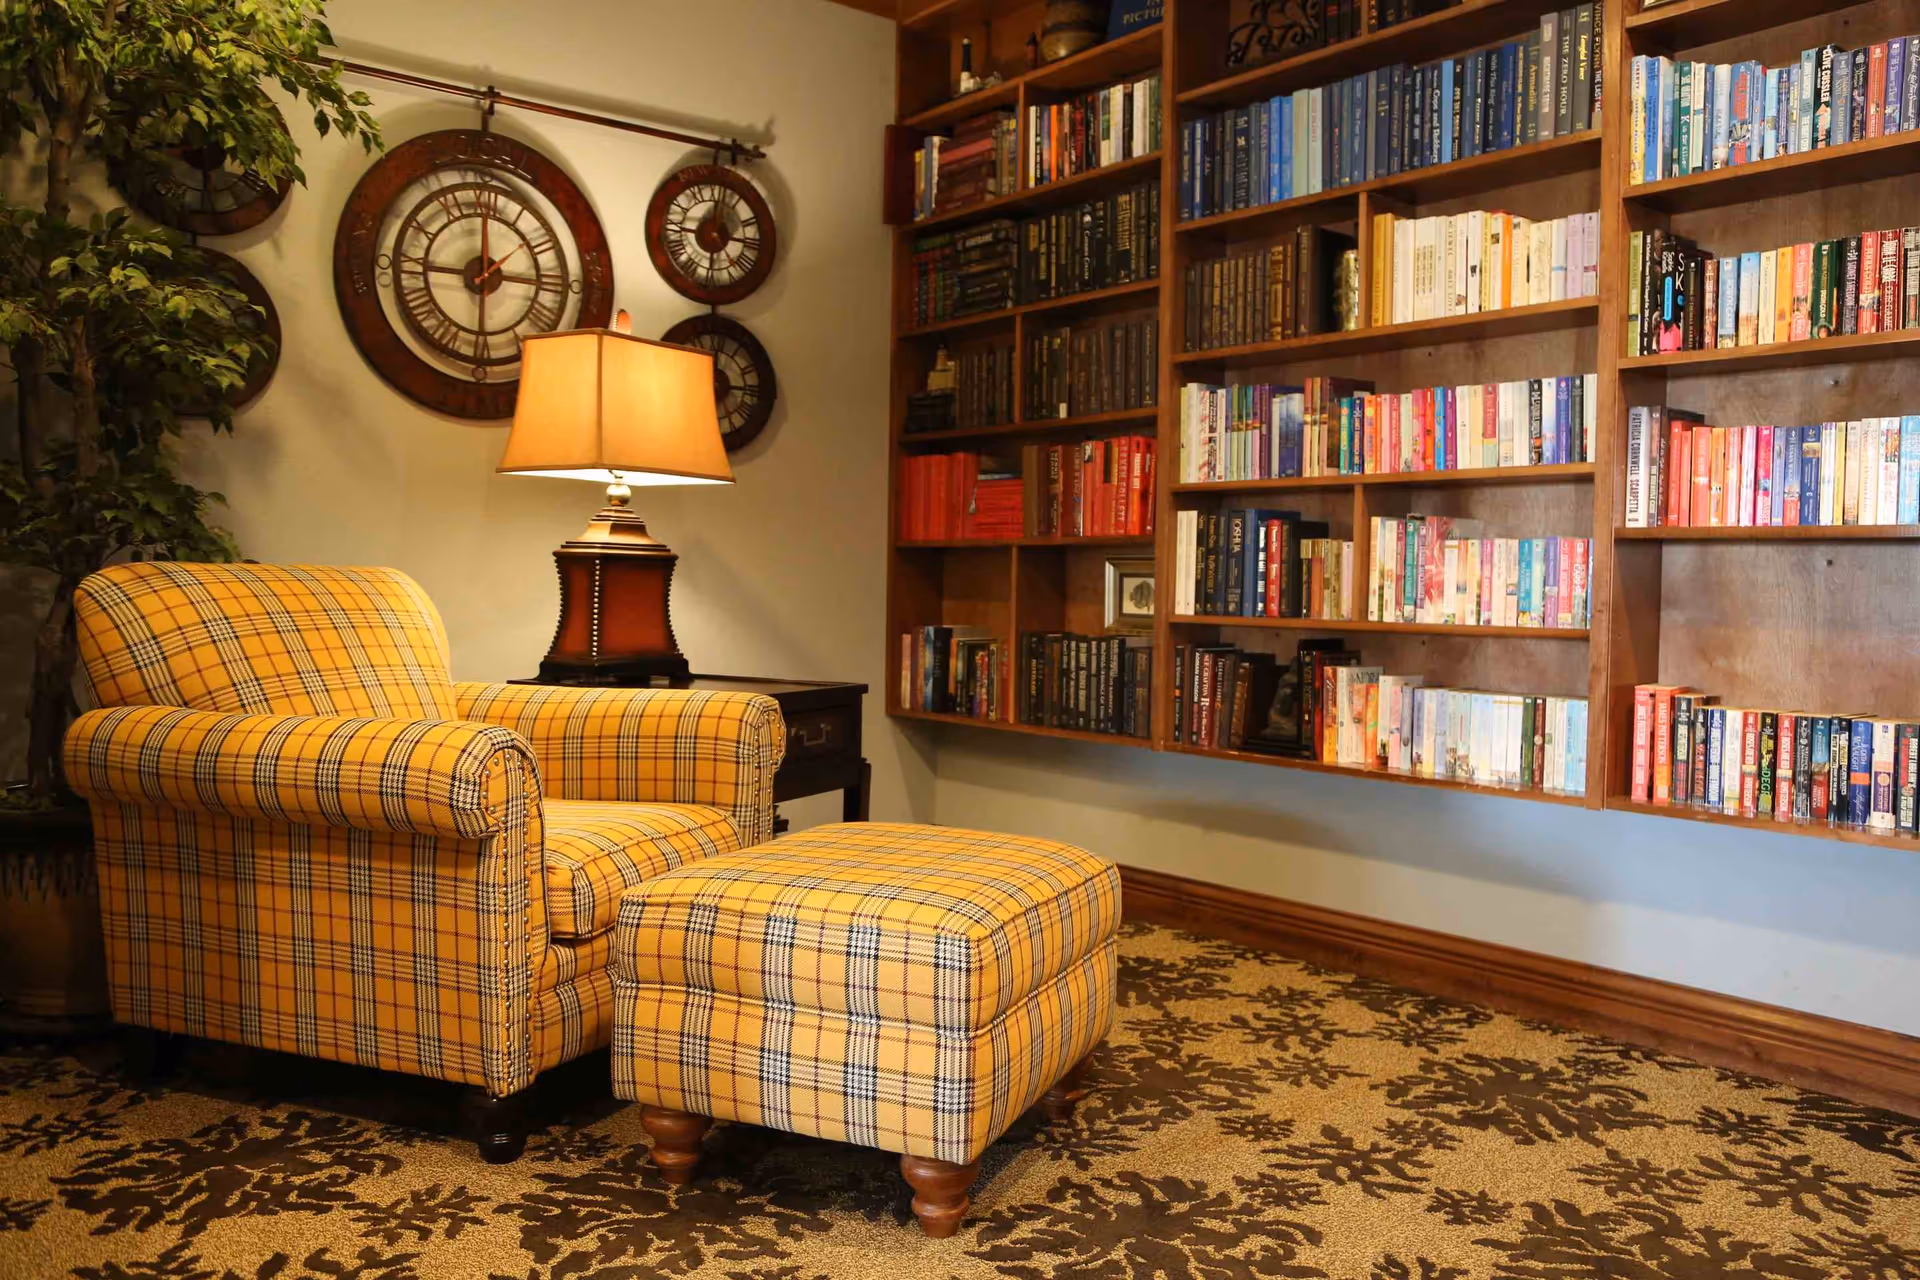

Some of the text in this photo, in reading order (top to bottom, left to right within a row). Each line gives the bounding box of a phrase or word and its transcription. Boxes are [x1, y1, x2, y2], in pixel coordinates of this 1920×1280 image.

[1593, 2, 1602, 35] VINCE
[1822, 49, 1832, 70] CLIVE
[1559, 35, 1570, 117] THE ZERO HOUR
[1595, 70, 1603, 83] THE
[1820, 70, 1831, 103] CUSSLER
[1594, 85, 1603, 99] LAST
[1431, 89, 1441, 164] Cops and Robbers
[1680, 114, 1690, 124] K
[1681, 146, 1689, 169] Killer
[1881, 240, 1898, 255] JOHN
[1661, 251, 1669, 274] Kinsella
[1667, 251, 1676, 272] Sophie
[1846, 261, 1857, 306] SIDNEY SHELDON
[1628, 413, 1642, 514] PATRICIA CORNWELL SCARPETTA
[1231, 518, 1243, 553] JOSHUA
[1200, 697, 1210, 706] R
[1657, 724, 1667, 764] PATTERSON
[1860, 743, 1869, 765] JUDITH
[1907, 737, 1918, 788] ROBERT LUDLUM'S
[1852, 790, 1865, 815] Perfect
